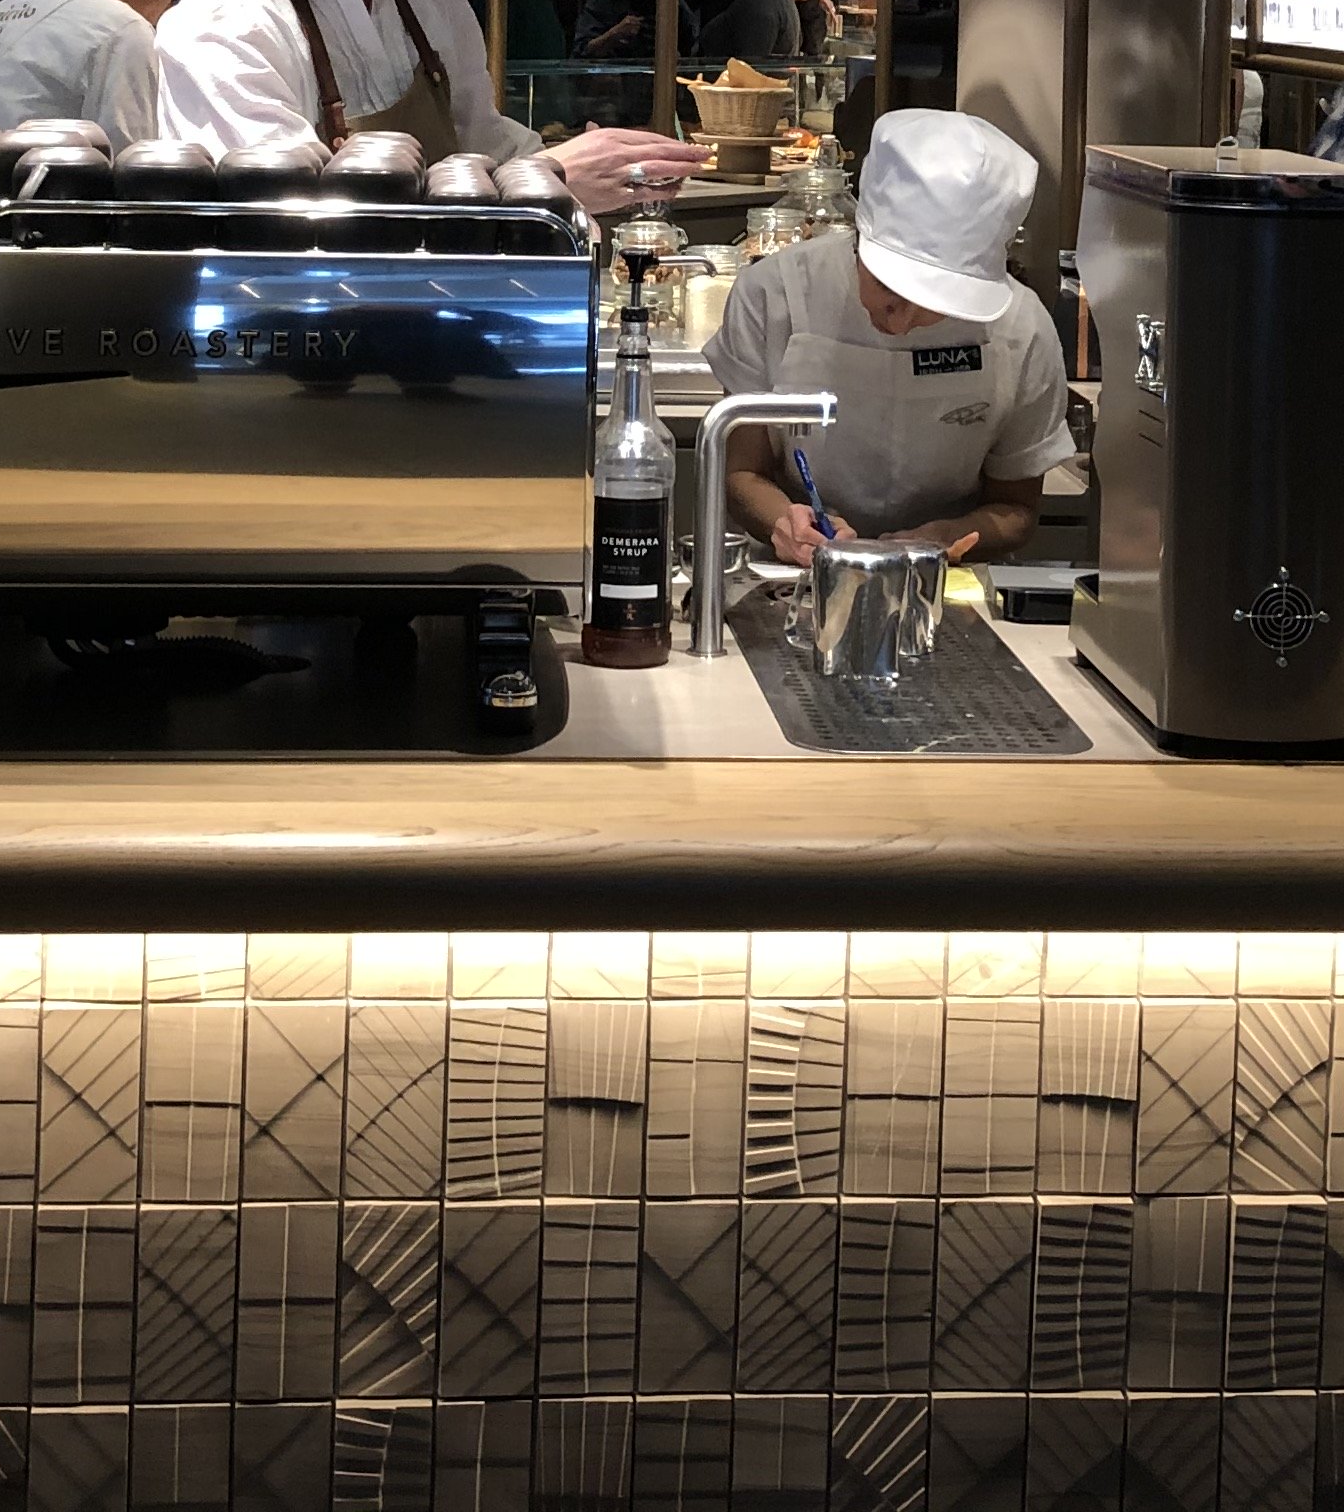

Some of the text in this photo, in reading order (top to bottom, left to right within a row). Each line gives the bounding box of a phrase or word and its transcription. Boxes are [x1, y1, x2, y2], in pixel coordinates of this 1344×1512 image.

[99, 327, 357, 359] ROASTERY
[601, 536, 660, 547] DEMERARA
[613, 547, 648, 557] SYRUP
